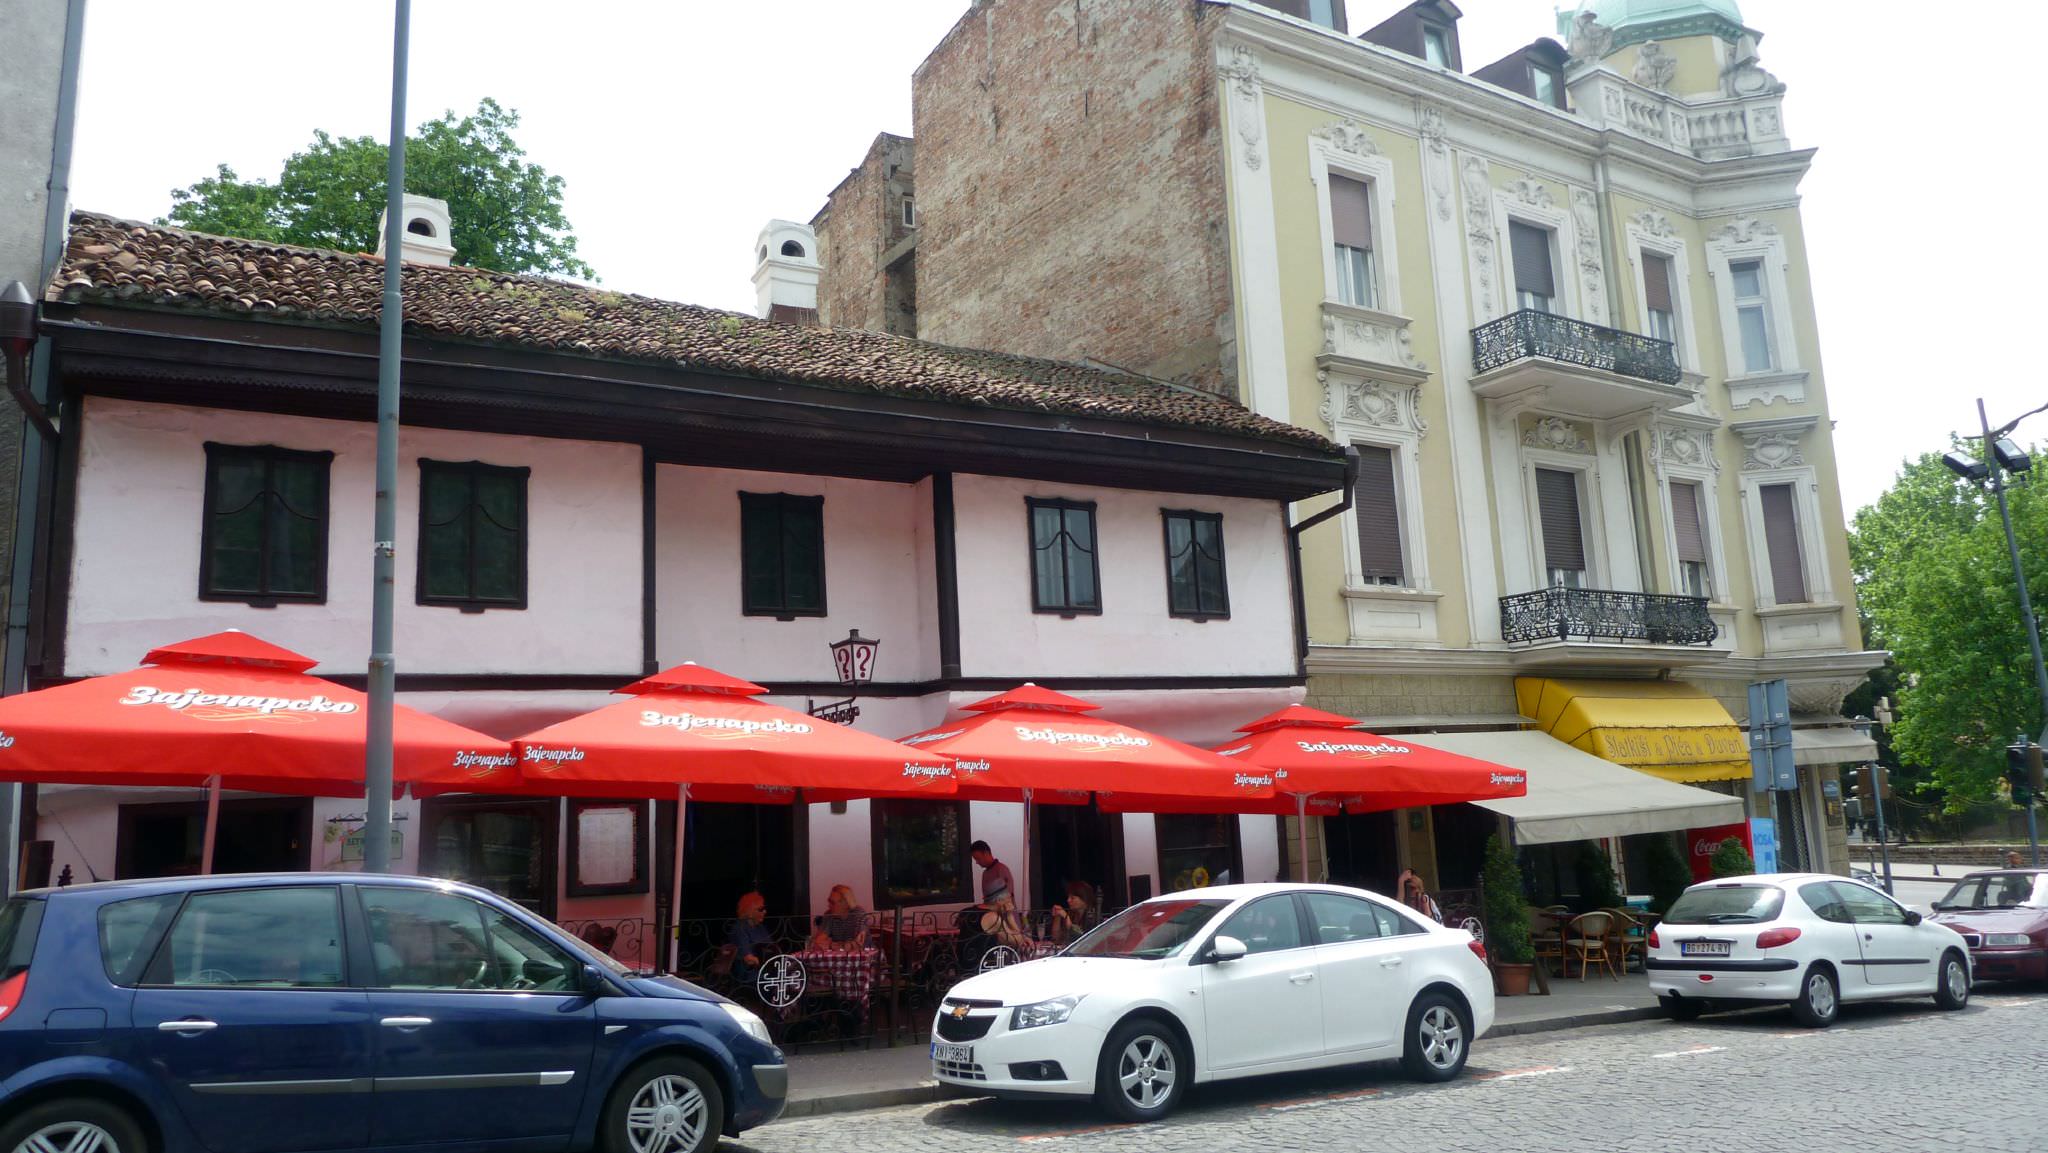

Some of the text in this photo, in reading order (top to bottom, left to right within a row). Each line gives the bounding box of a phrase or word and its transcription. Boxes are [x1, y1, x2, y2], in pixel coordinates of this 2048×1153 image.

[838, 648, 850, 680] ?
[856, 646, 871, 678] ?
[119, 686, 359, 714] Зајечарско
[639, 710, 814, 734] Зајечарско
[1014, 726, 1152, 747] Зајечарско
[523, 745, 585, 764] Зајечарско
[1296, 741, 1412, 755] Зајечарско
[453, 750, 518, 769] Зајечарско
[955, 758, 990, 774] јечарско
[902, 762, 952, 778] Зајечарско
